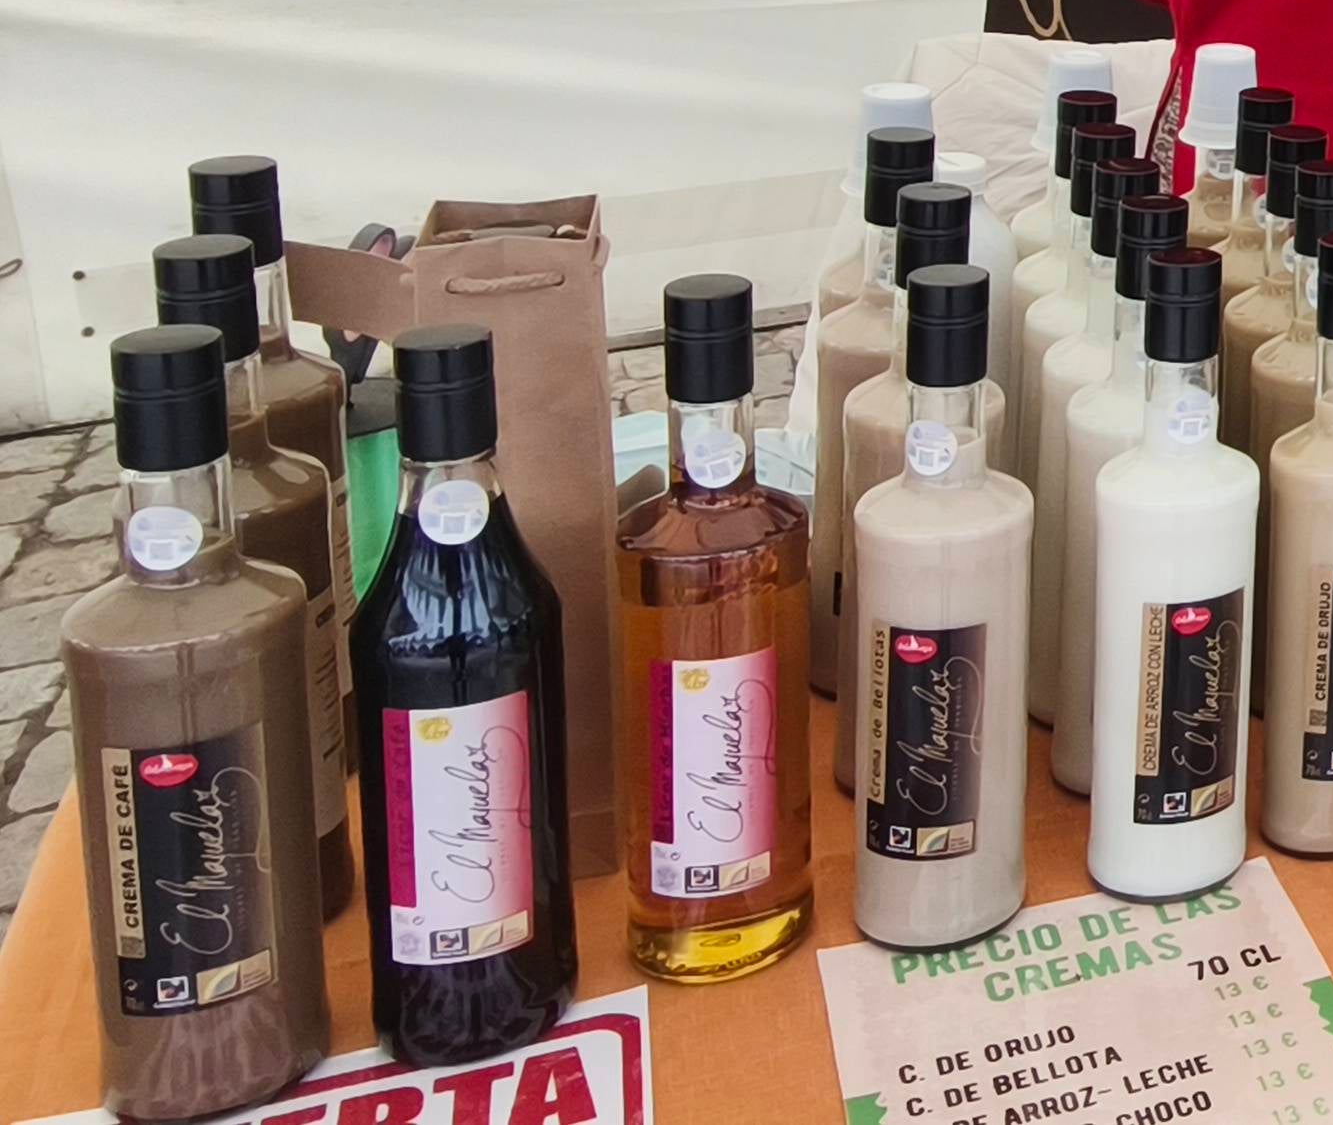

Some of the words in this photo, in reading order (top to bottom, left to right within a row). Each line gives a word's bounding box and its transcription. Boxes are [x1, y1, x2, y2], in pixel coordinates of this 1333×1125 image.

[1148, 607, 1163, 642] LECHE
[1147, 645, 1161, 669] CON
[1145, 672, 1160, 710] ARROZ
[1145, 714, 1158, 729] DE
[1143, 731, 1157, 771] CREMA
[112, 764, 132, 817] CAFÉ
[118, 824, 134, 851] DE
[119, 859, 140, 929] CREMA
[891, 923, 1063, 984] PRECIO
[1078, 905, 1139, 946] DE
[1155, 885, 1241, 924] LAS
[983, 932, 1183, 1002] CREMAS
[1188, 955, 1229, 981] 70
[1240, 944, 1281, 968] CL
[898, 1065, 925, 1084] C.
[937, 1051, 974, 1075] DE
[984, 1025, 1075, 1063] ORUJO
[1215, 983, 1242, 1001] 13
[1253, 975, 1269, 990] €
[906, 1097, 933, 1117] C.
[944, 1083, 982, 1108] DE
[993, 1047, 1122, 1095] BELLOTA
[1228, 1010, 1256, 1028] 13
[1267, 1003, 1283, 1019] €
[1123, 1055, 1213, 1094] LECHE
[1241, 1040, 1270, 1060] 13
[1282, 1032, 1298, 1048] €
[1115, 1091, 1212, 1125] CHOCO
[1256, 1071, 1286, 1092] 13
[1297, 1063, 1314, 1080] €
[1313, 1097, 1330, 1116] €
